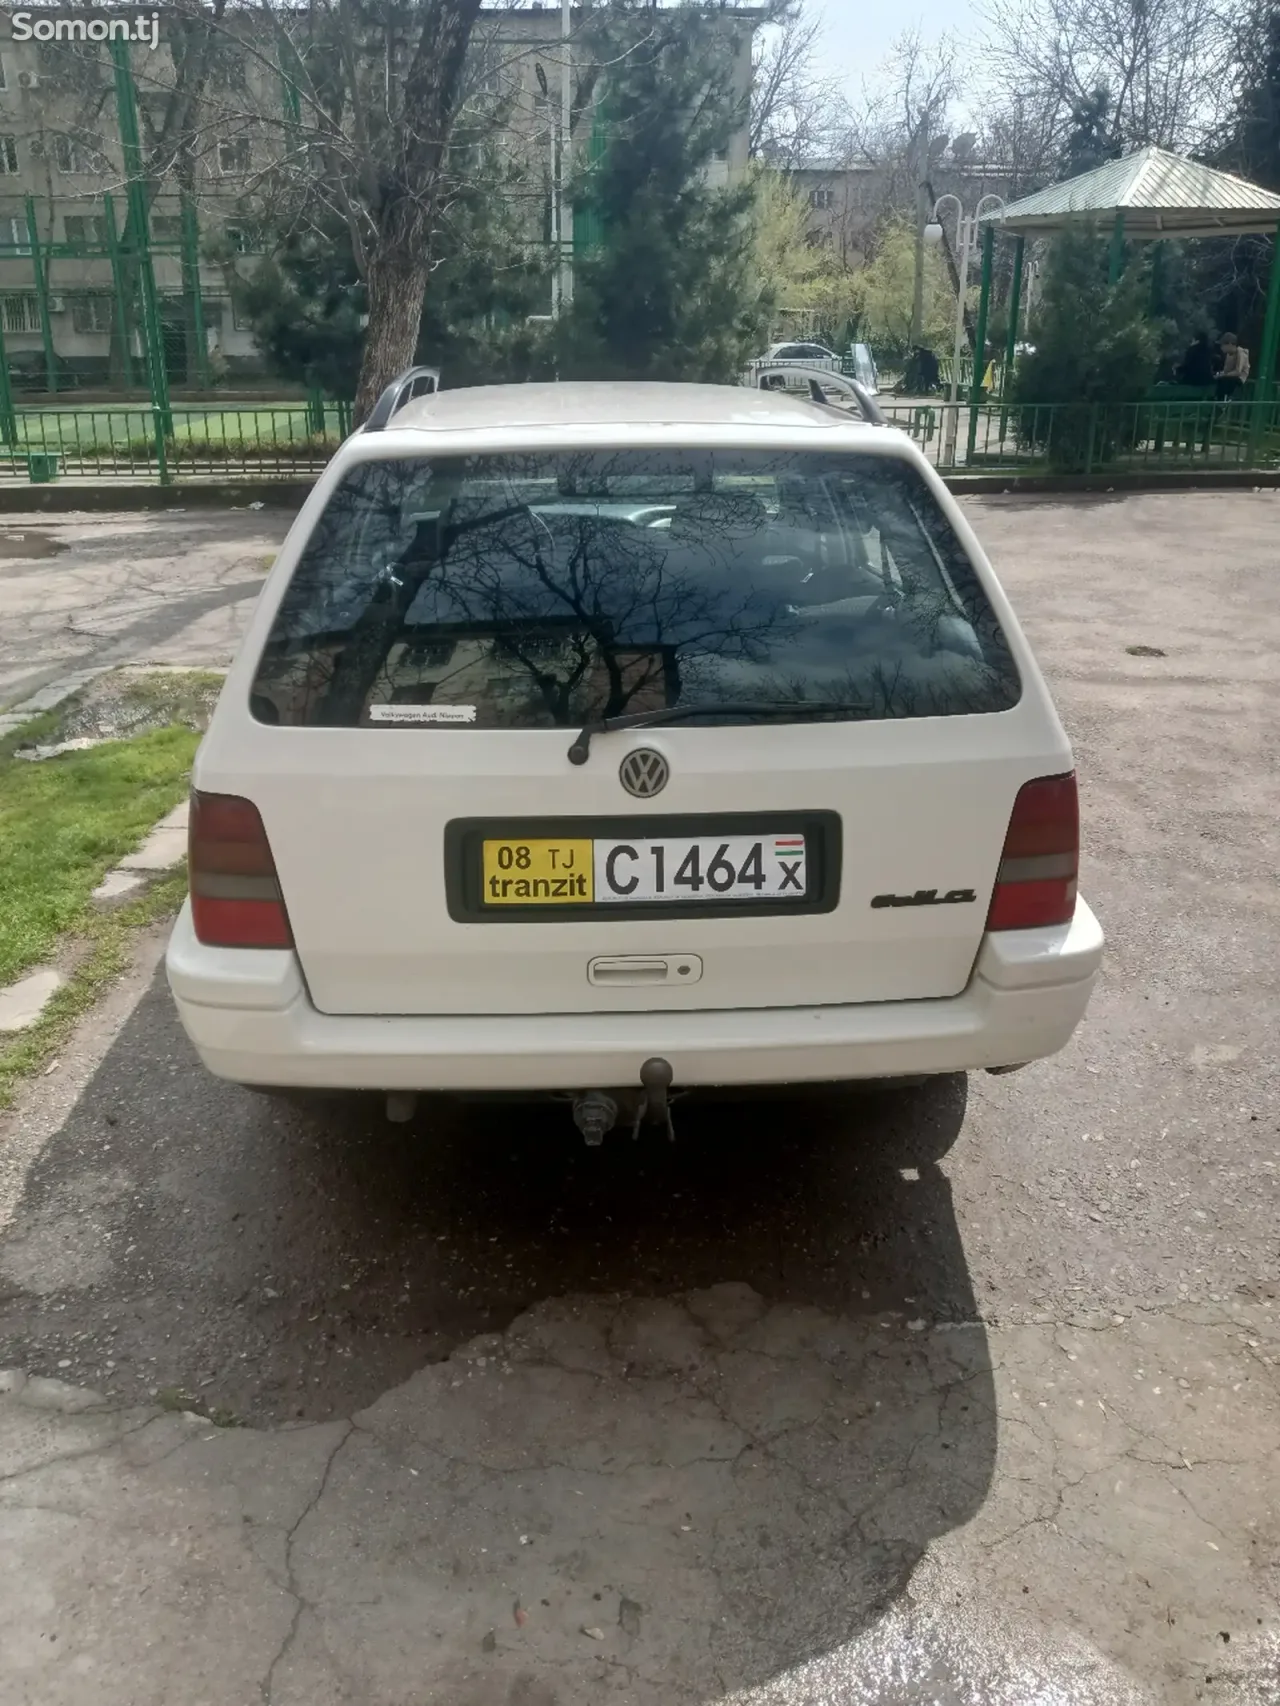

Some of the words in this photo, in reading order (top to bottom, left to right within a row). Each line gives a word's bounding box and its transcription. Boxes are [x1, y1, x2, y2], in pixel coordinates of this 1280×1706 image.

[619, 747, 670, 798] VW
[498, 846, 532, 870] 08
[548, 849, 574, 870] TJ
[605, 843, 766, 895] C1464
[489, 873, 587, 897] tranzit
